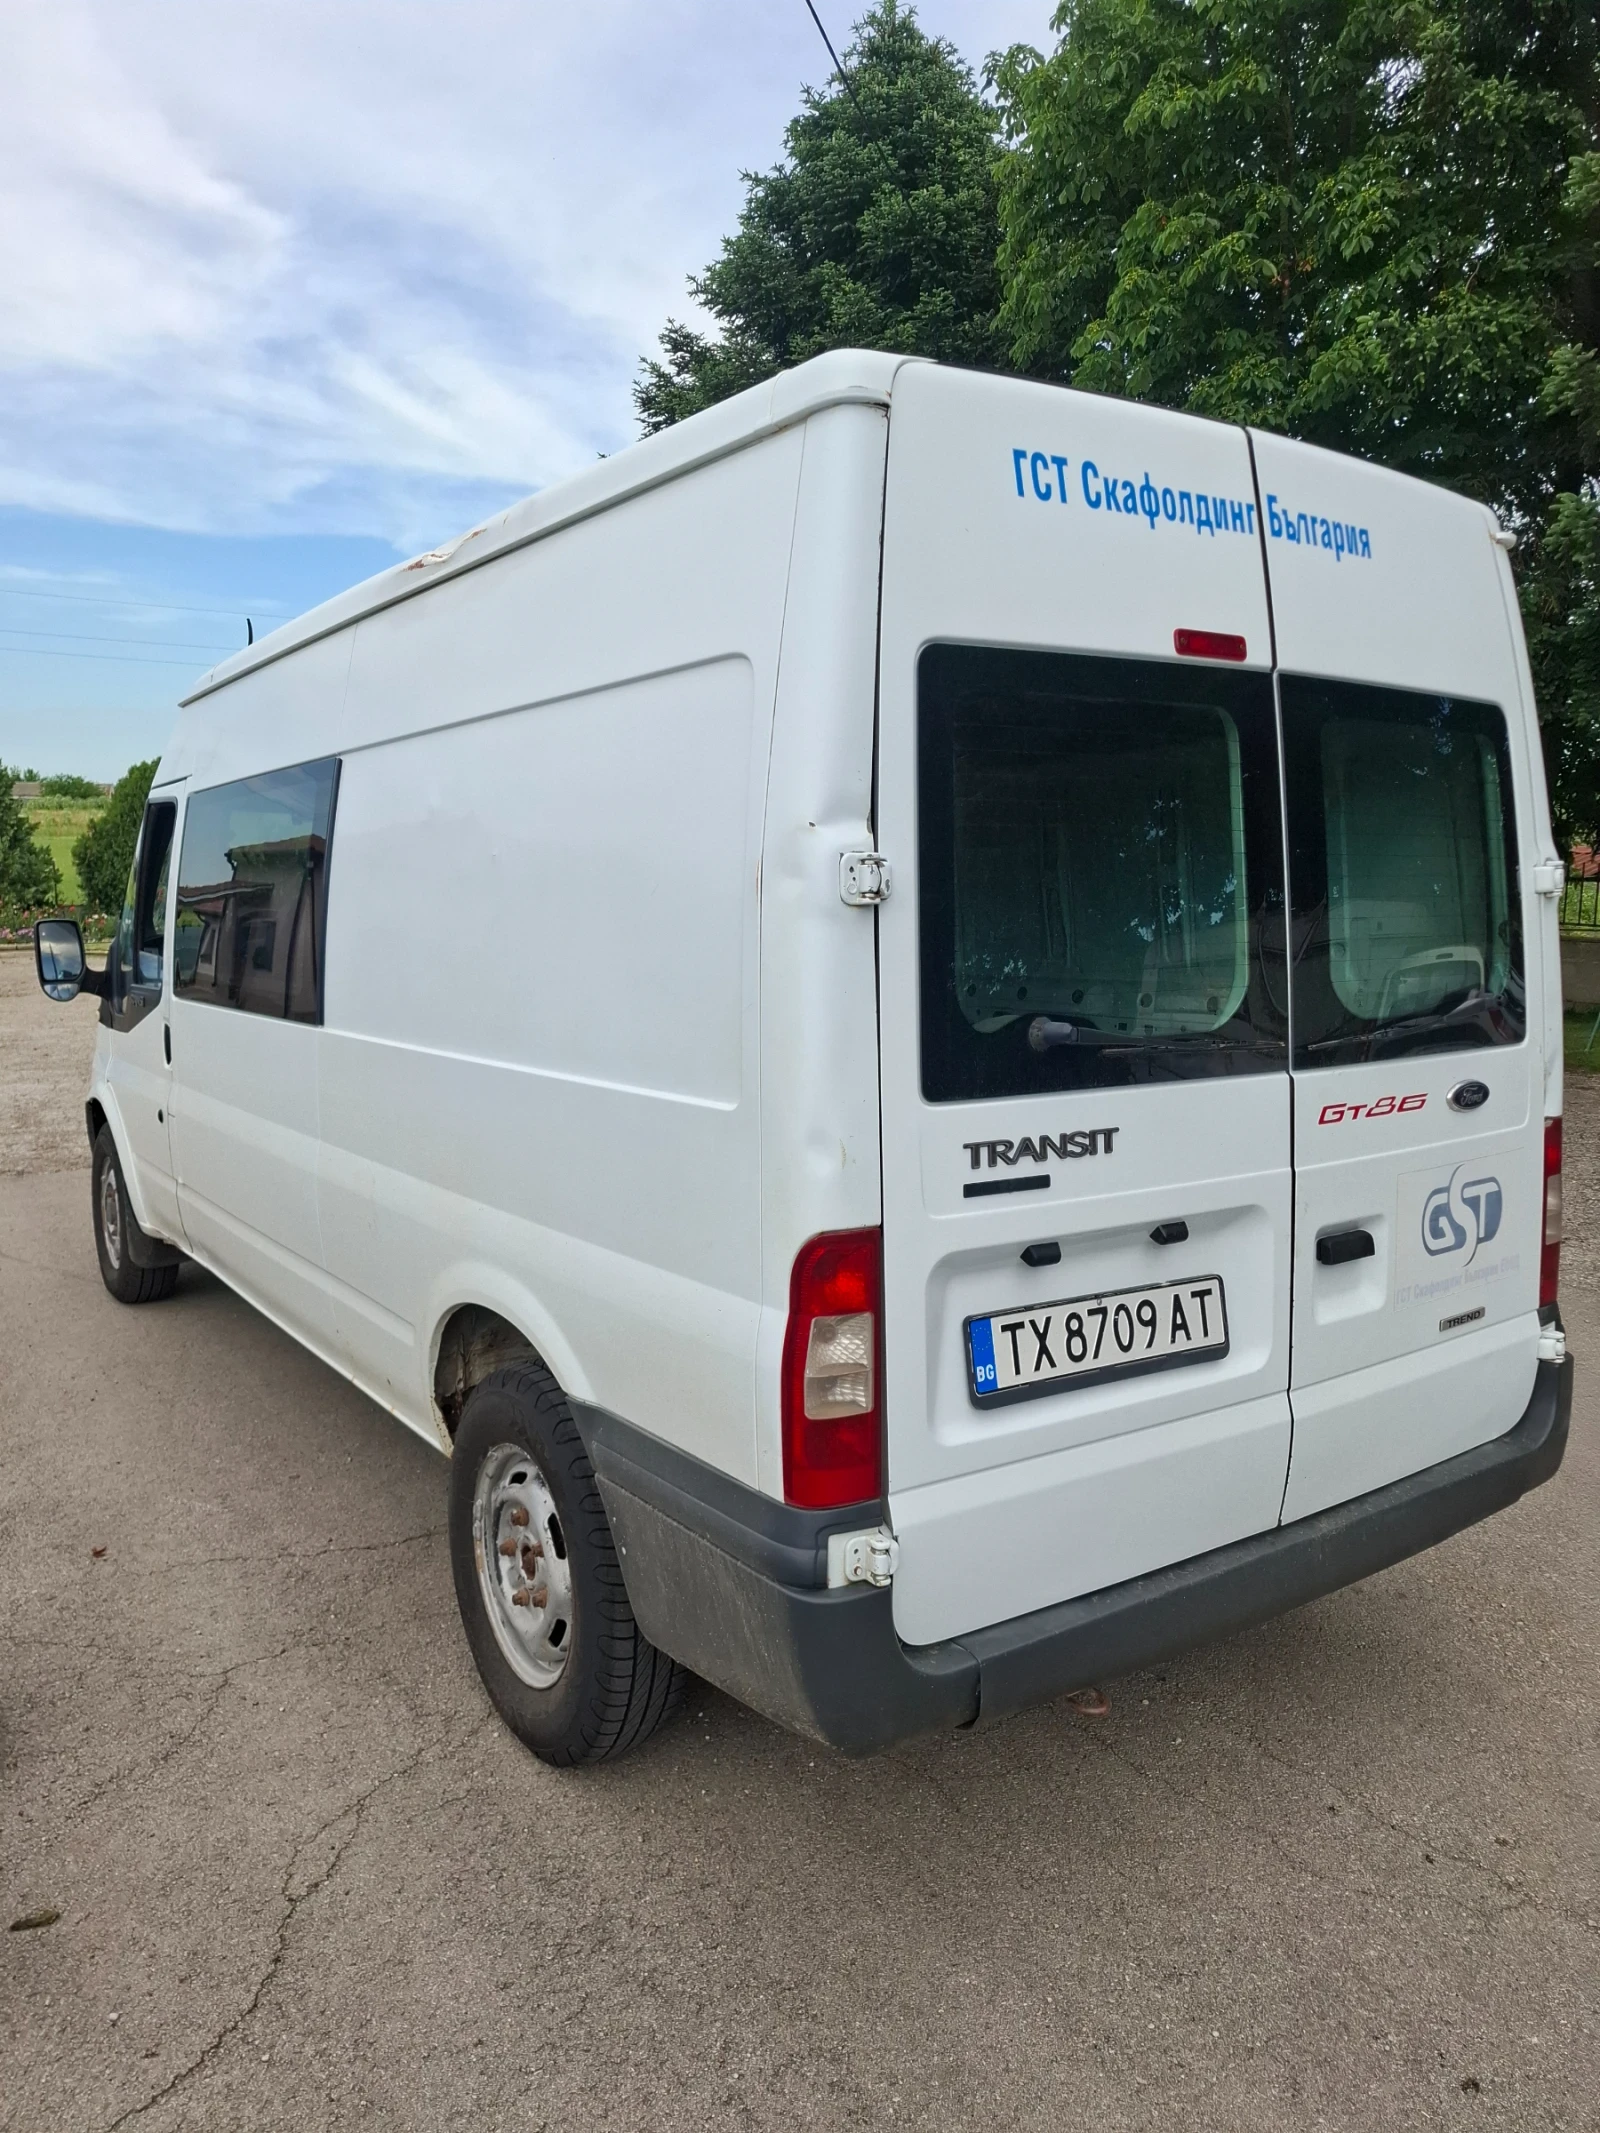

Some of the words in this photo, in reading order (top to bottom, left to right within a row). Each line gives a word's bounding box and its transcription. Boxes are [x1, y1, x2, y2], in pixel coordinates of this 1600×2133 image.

[1012, 448, 1069, 504] ГСТ
[1081, 460, 1256, 538] Скафолдинг
[1266, 494, 1373, 562] България
[963, 1126, 1120, 1170] TRANSIT
[1422, 1164, 1504, 1268] GST
[1447, 1310, 1481, 1329] TREND
[976, 1366, 995, 1383] BG
